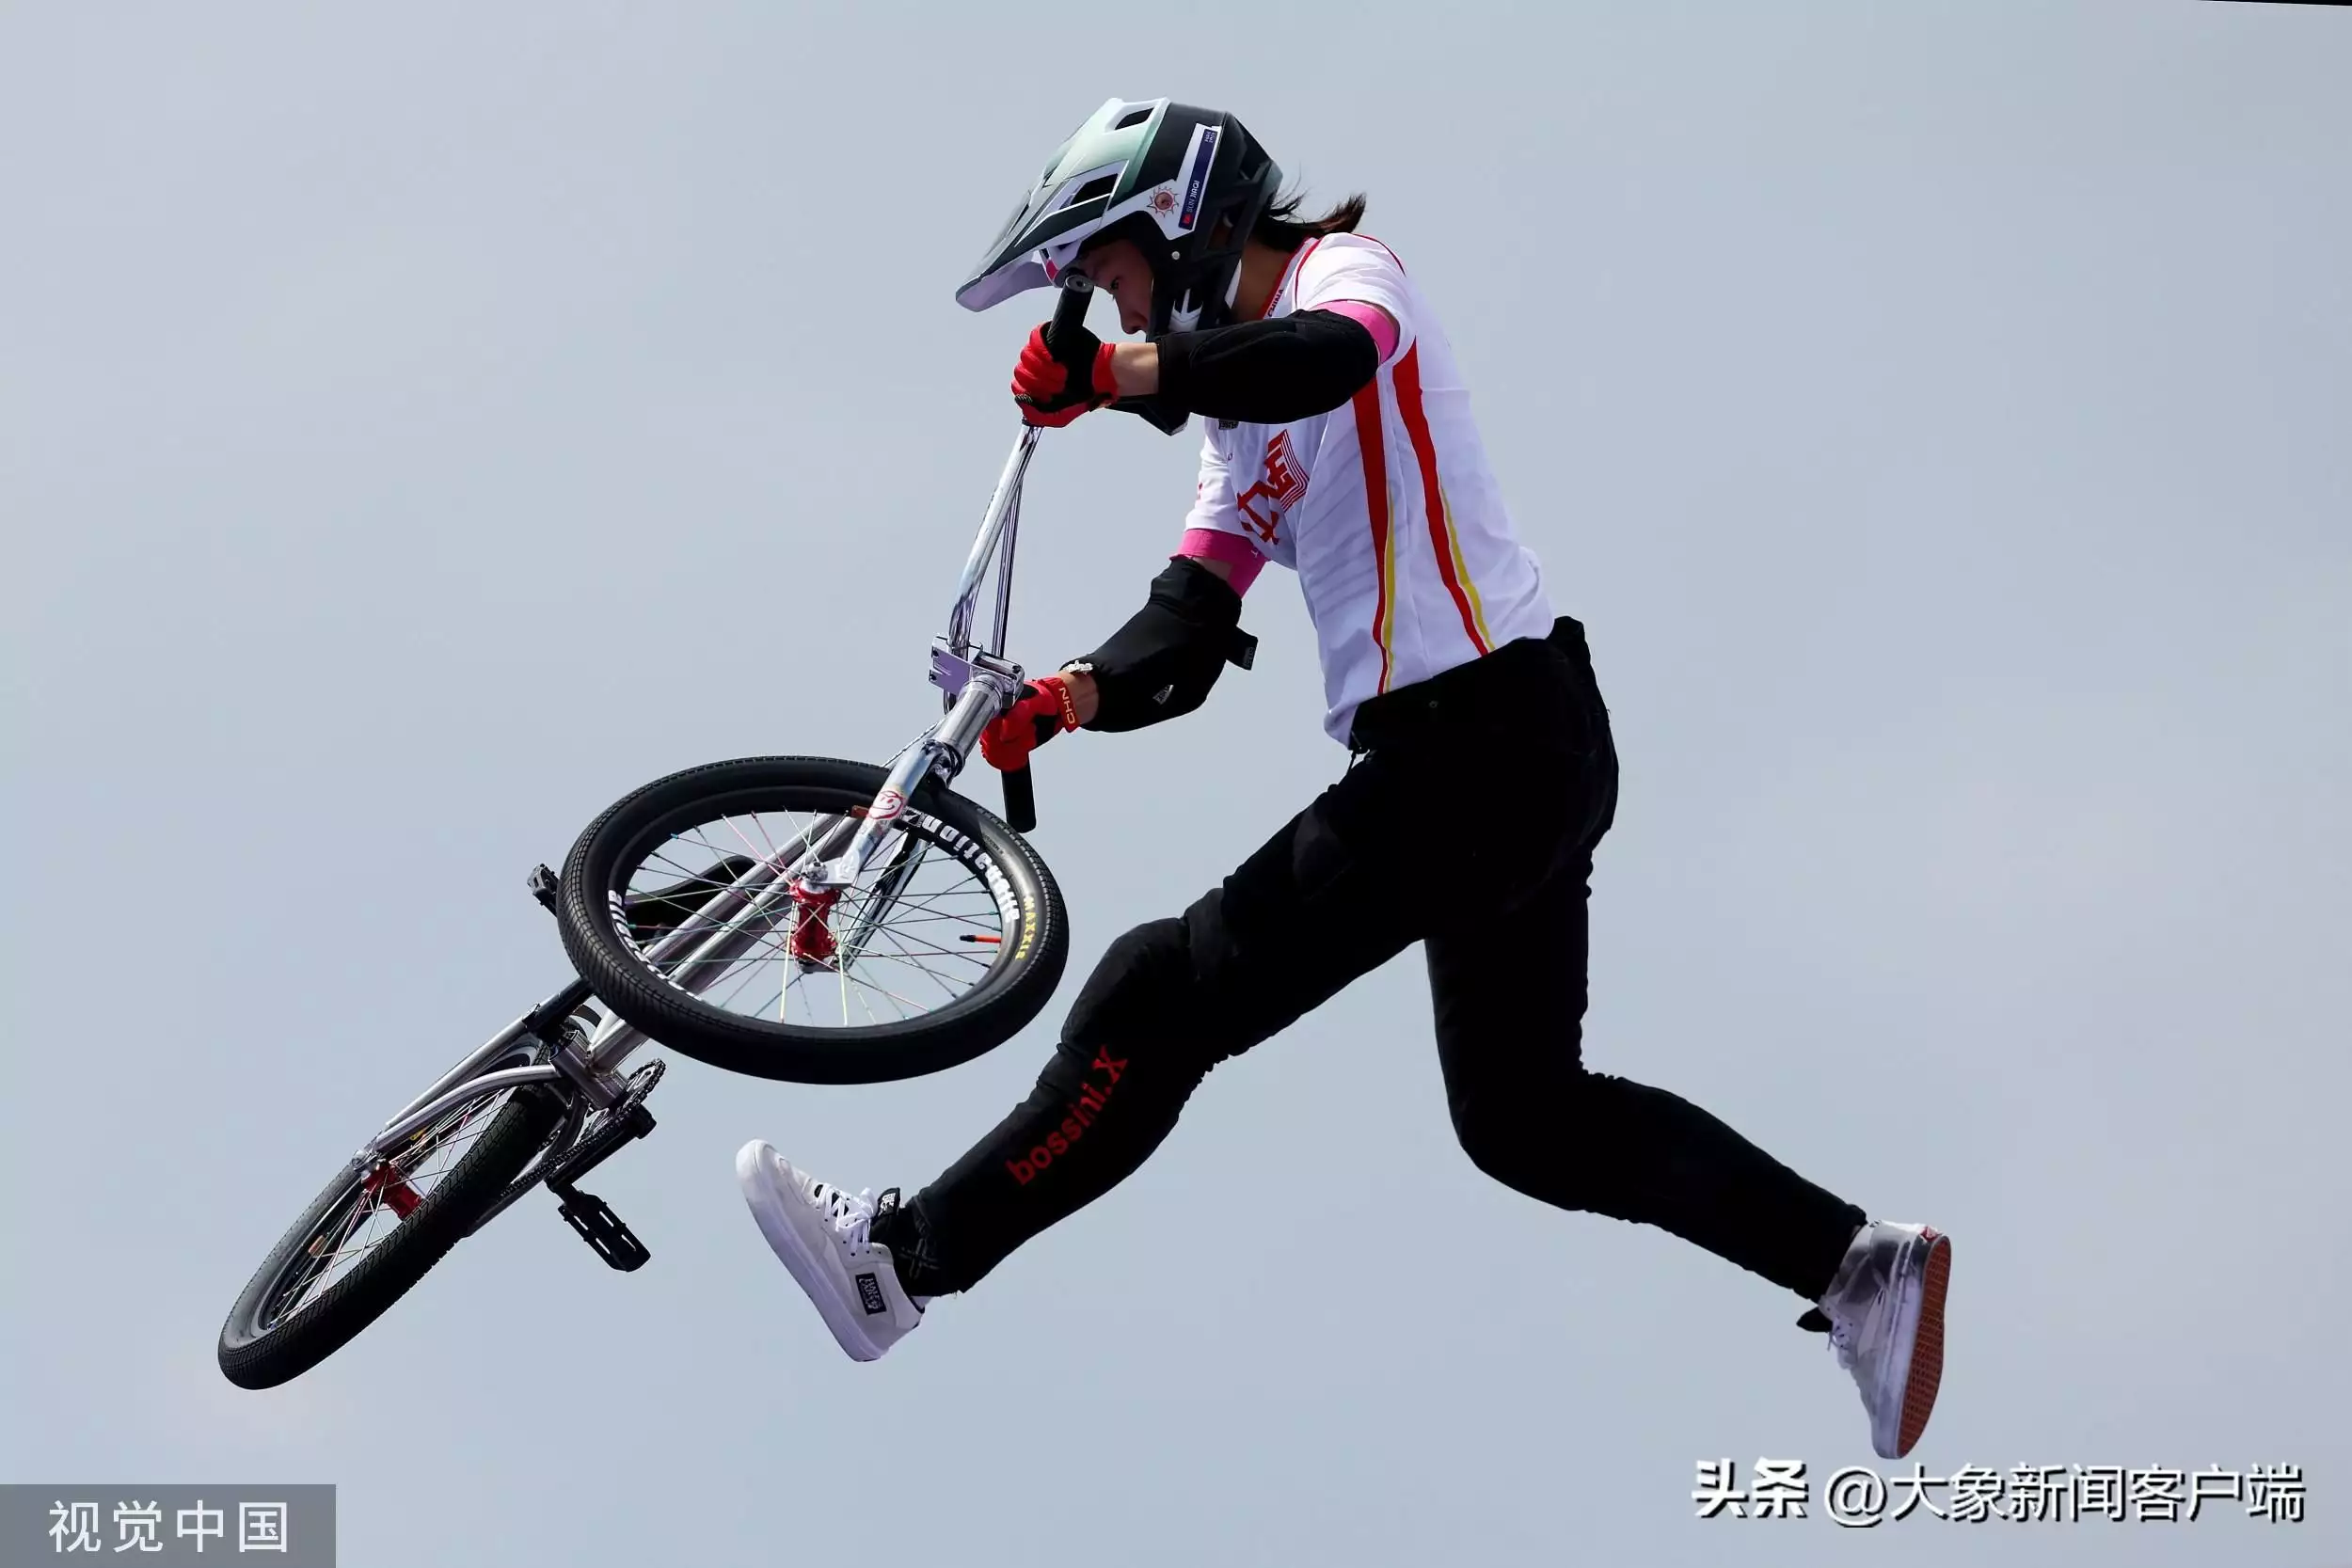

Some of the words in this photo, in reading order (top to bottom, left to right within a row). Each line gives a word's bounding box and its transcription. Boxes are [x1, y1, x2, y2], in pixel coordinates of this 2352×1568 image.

[1266, 288, 1285, 318] CHINA
[1058, 687, 1076, 725] CHN
[1014, 895, 1037, 960] MAXXIS
[1006, 1045, 1128, 1185] bossini.X
